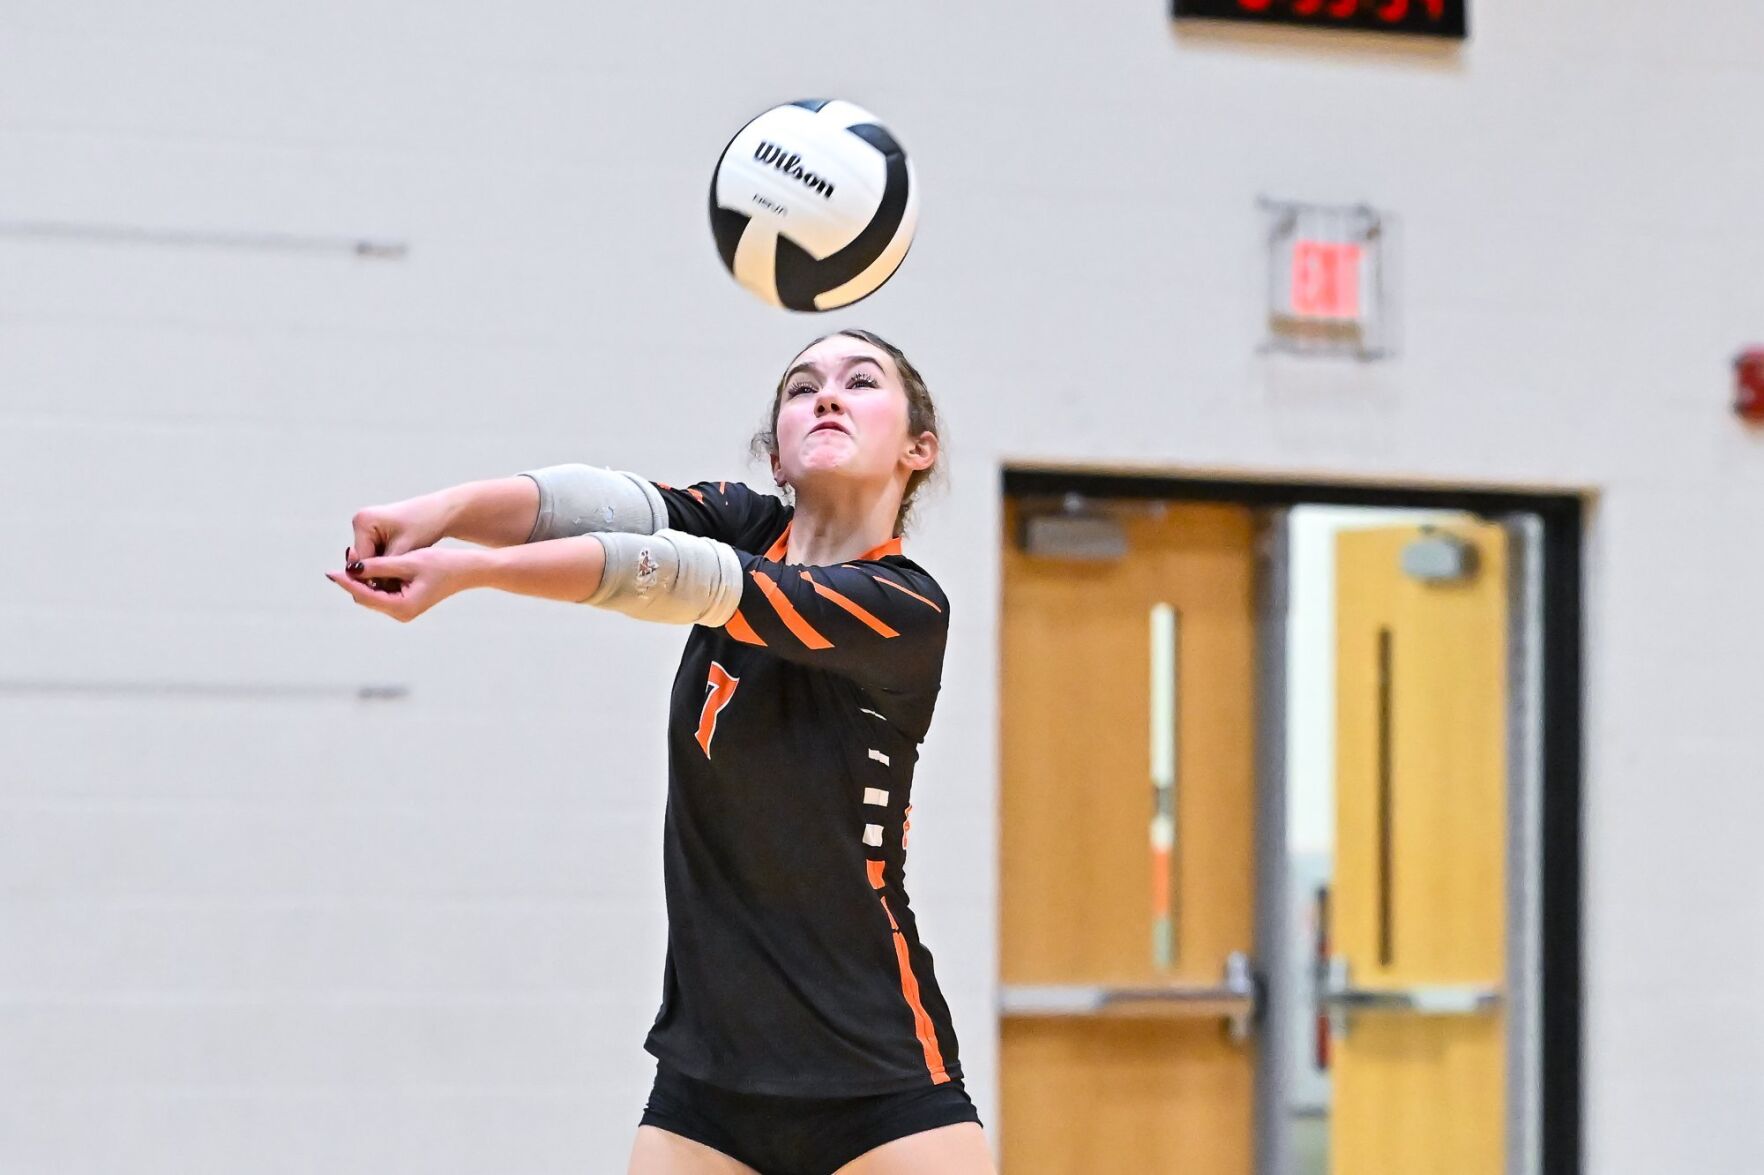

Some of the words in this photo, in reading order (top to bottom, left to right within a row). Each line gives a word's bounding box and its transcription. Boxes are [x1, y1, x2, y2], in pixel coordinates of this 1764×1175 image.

[754, 141, 834, 199] Wilson
[1292, 241, 1361, 318] EXIT
[695, 660, 740, 760] 7
